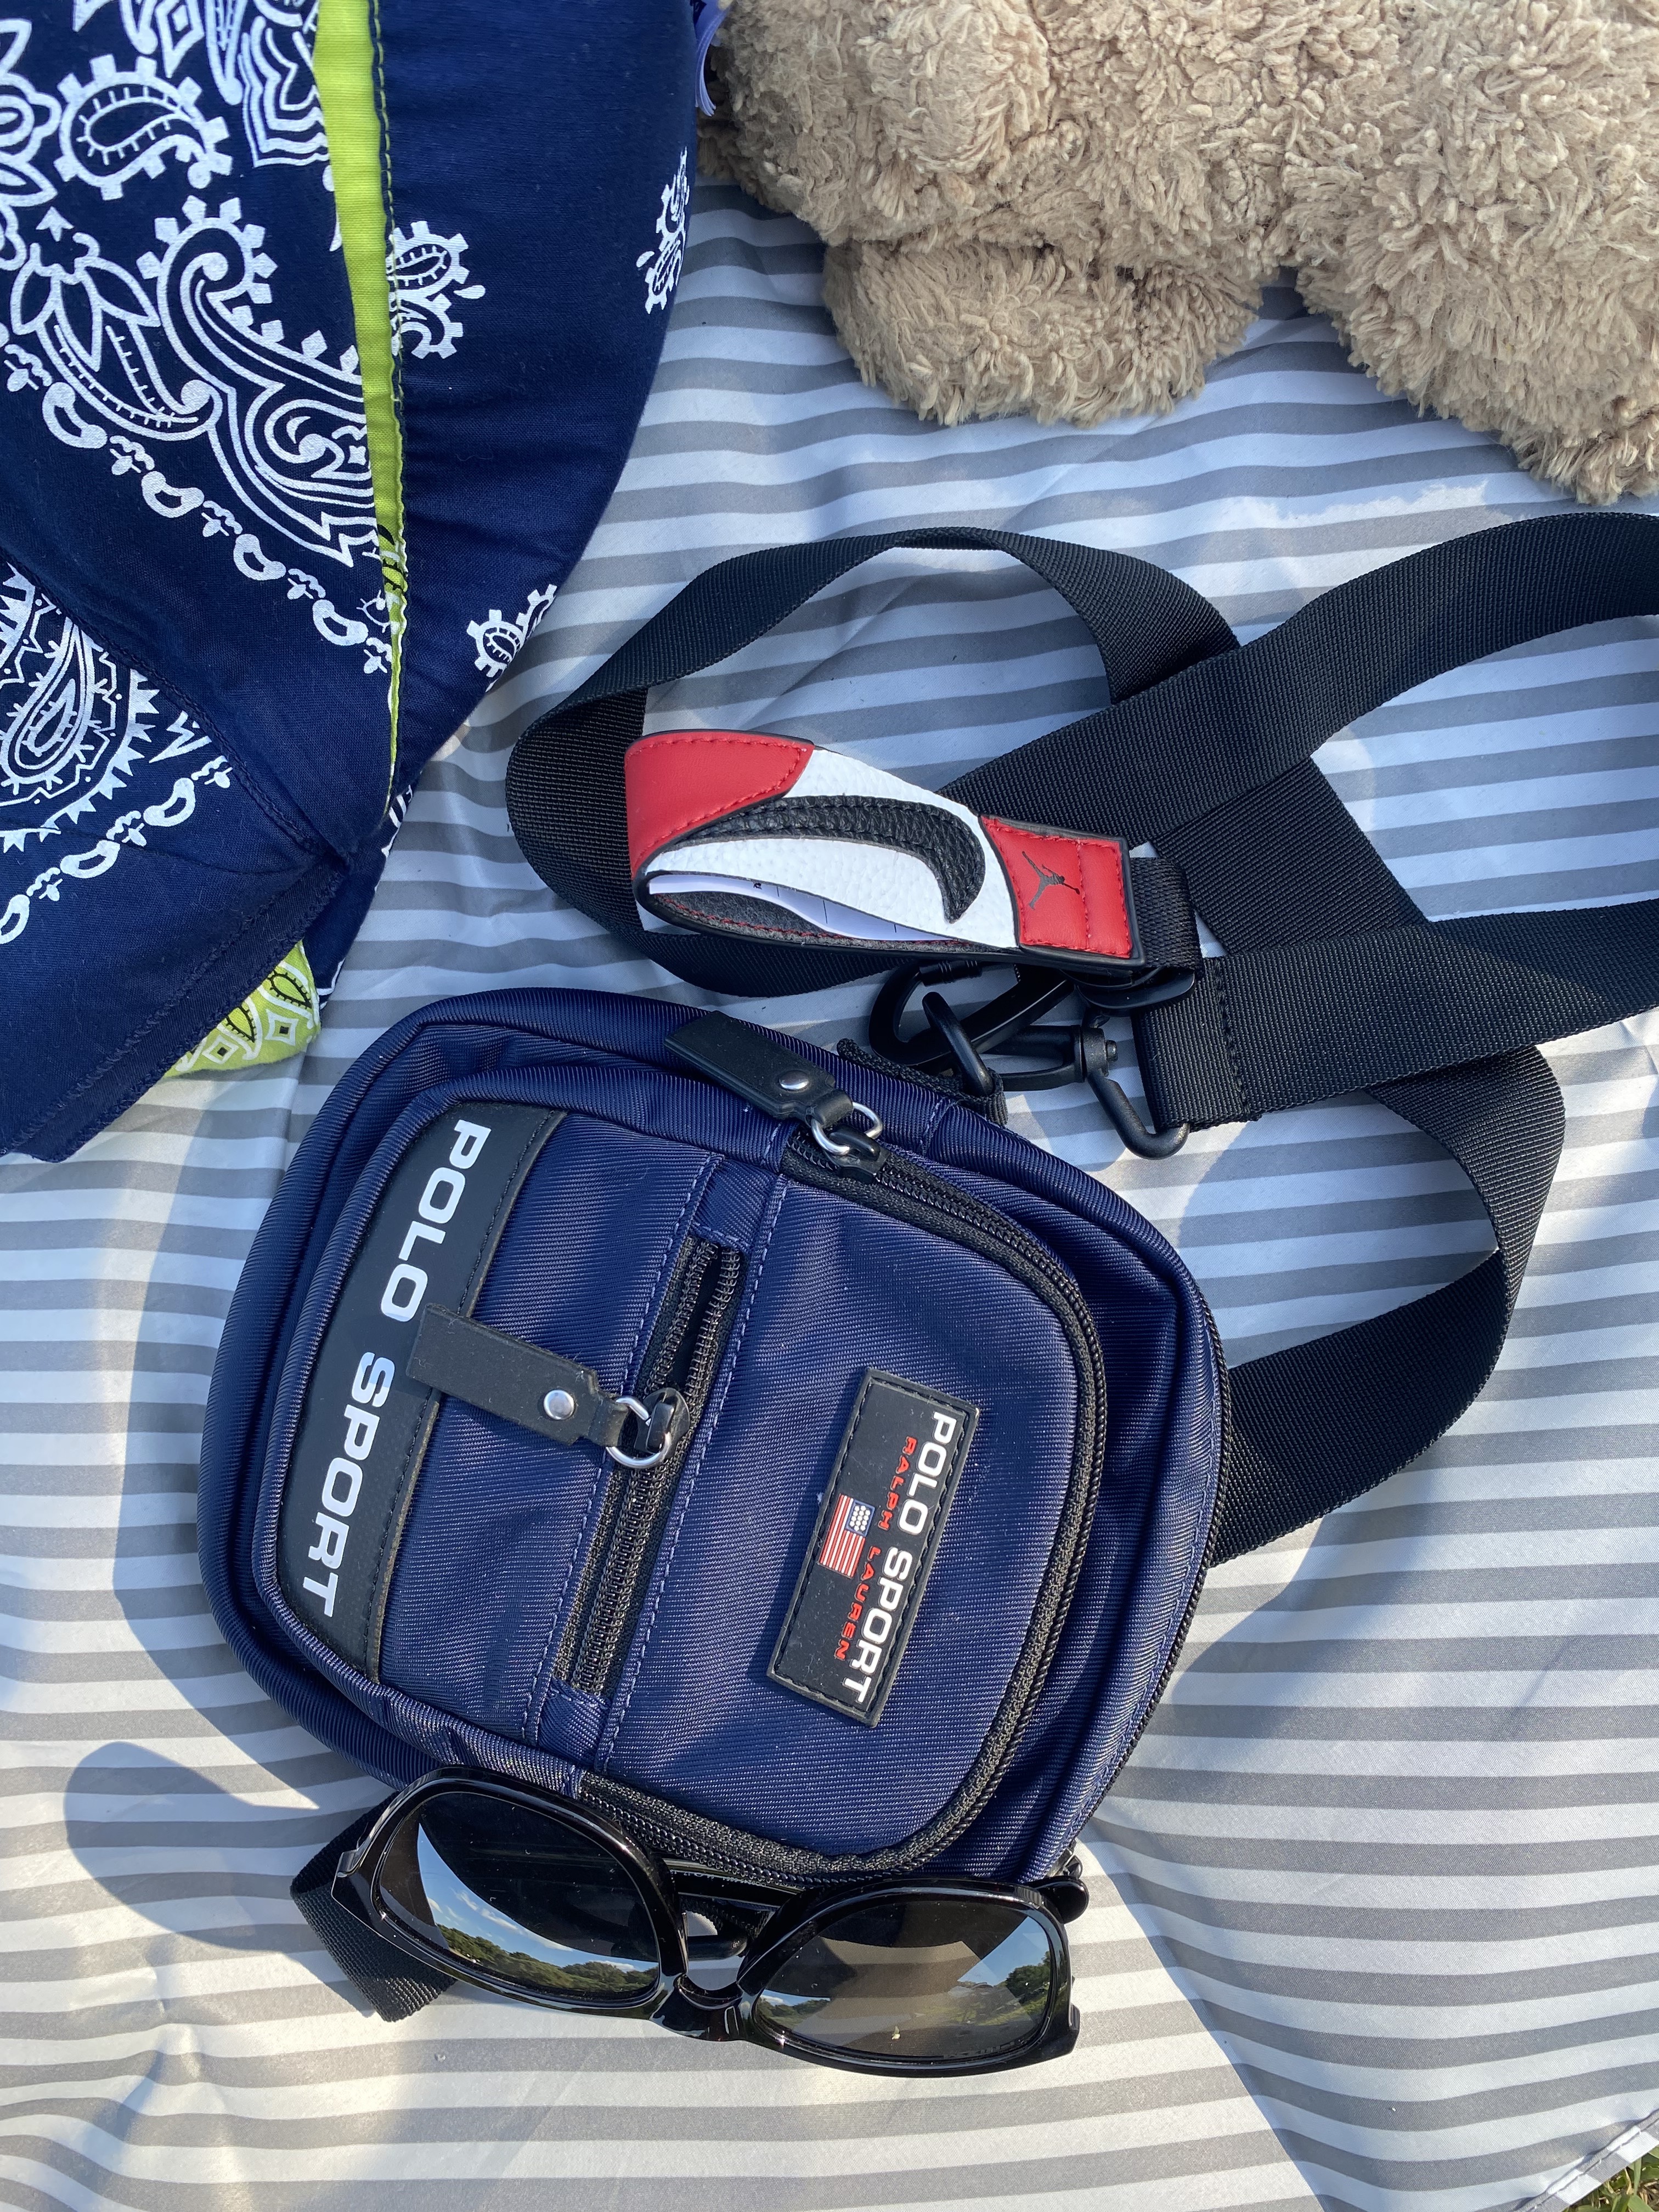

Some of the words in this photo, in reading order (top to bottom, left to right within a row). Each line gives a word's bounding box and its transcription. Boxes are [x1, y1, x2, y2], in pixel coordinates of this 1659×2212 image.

[380, 1119, 492, 1323] POLO
[302, 1352, 396, 1618] SPORT
[879, 1436, 918, 1530] RALPH
[899, 1410, 957, 1536] POLO
[835, 1546, 882, 1660] LAUREN
[844, 1546, 913, 1703] SPORT
